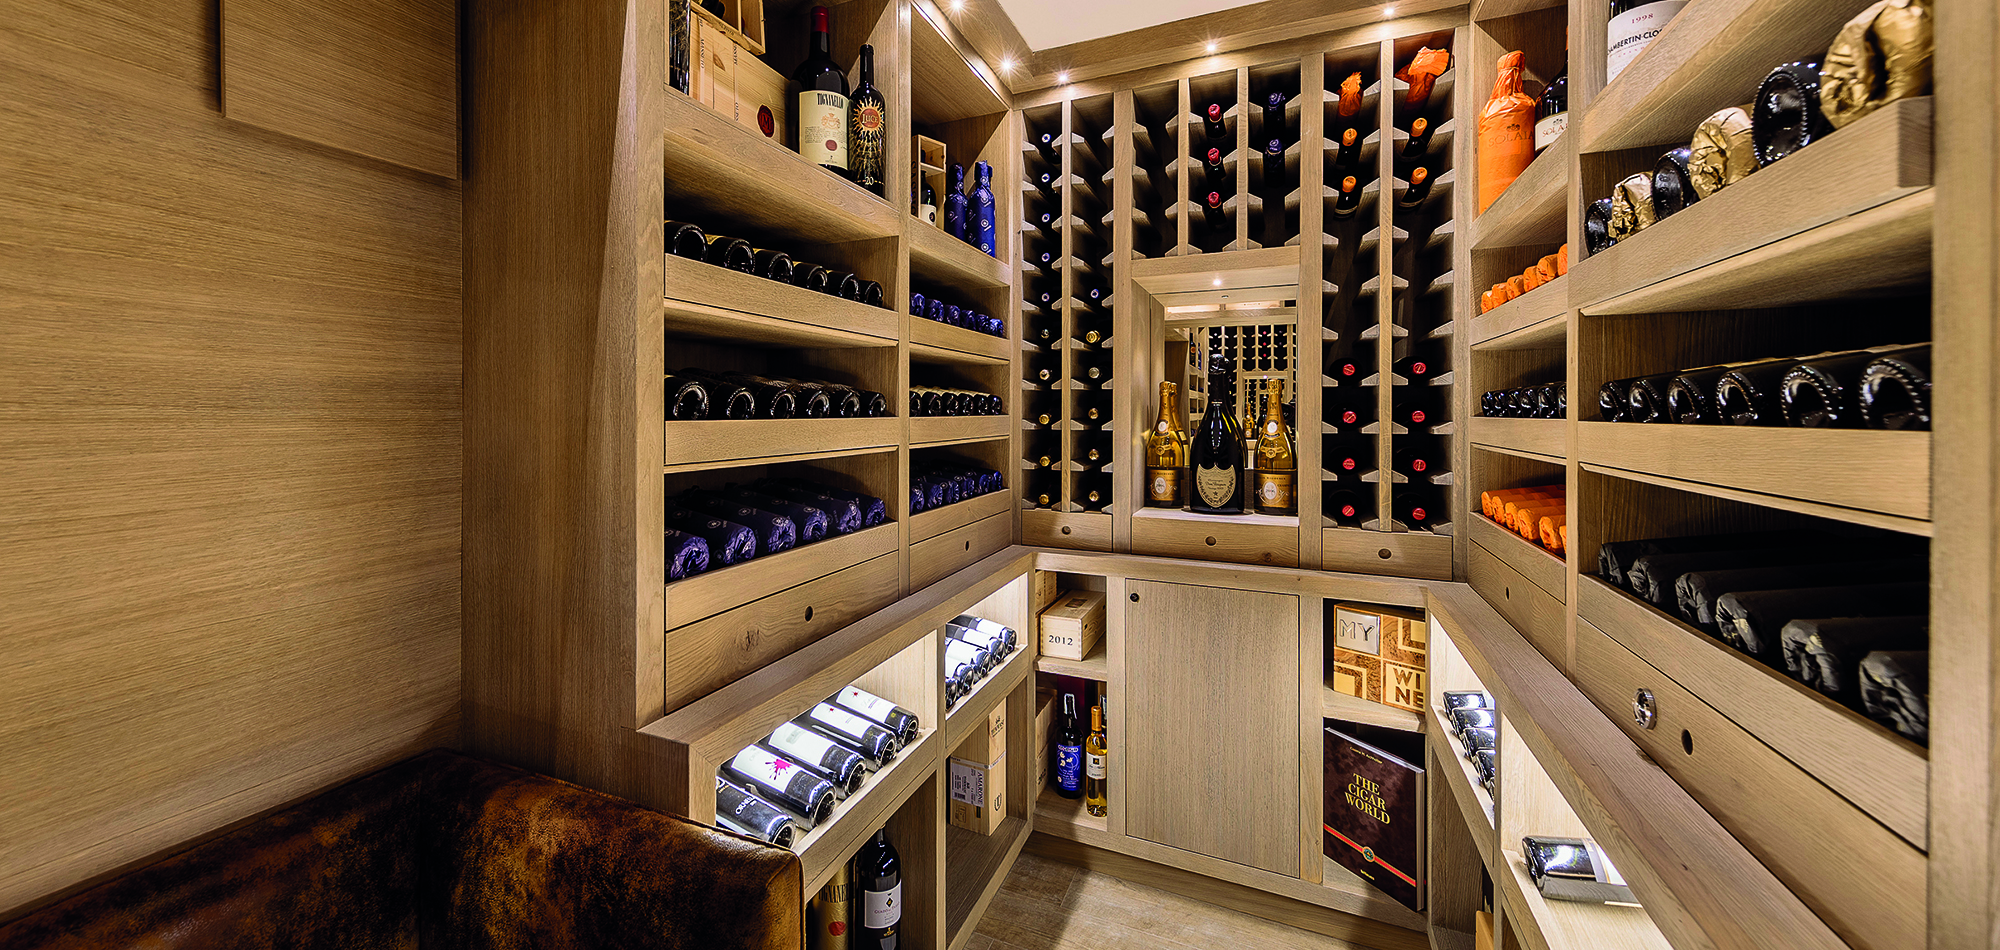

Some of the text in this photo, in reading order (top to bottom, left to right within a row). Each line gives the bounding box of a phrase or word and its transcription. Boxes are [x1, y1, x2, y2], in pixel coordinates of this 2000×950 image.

[1631, 13, 1654, 24] 1998
[817, 92, 844, 109] TIGNANELLO
[862, 113, 879, 124] LUCE
[1488, 130, 1535, 148] SOLAIA
[1340, 619, 1375, 642] MY
[1048, 634, 1073, 646] 2012
[1352, 772, 1380, 796] THE
[1347, 783, 1387, 812] CIGAR
[1344, 791, 1391, 825] WORLD
